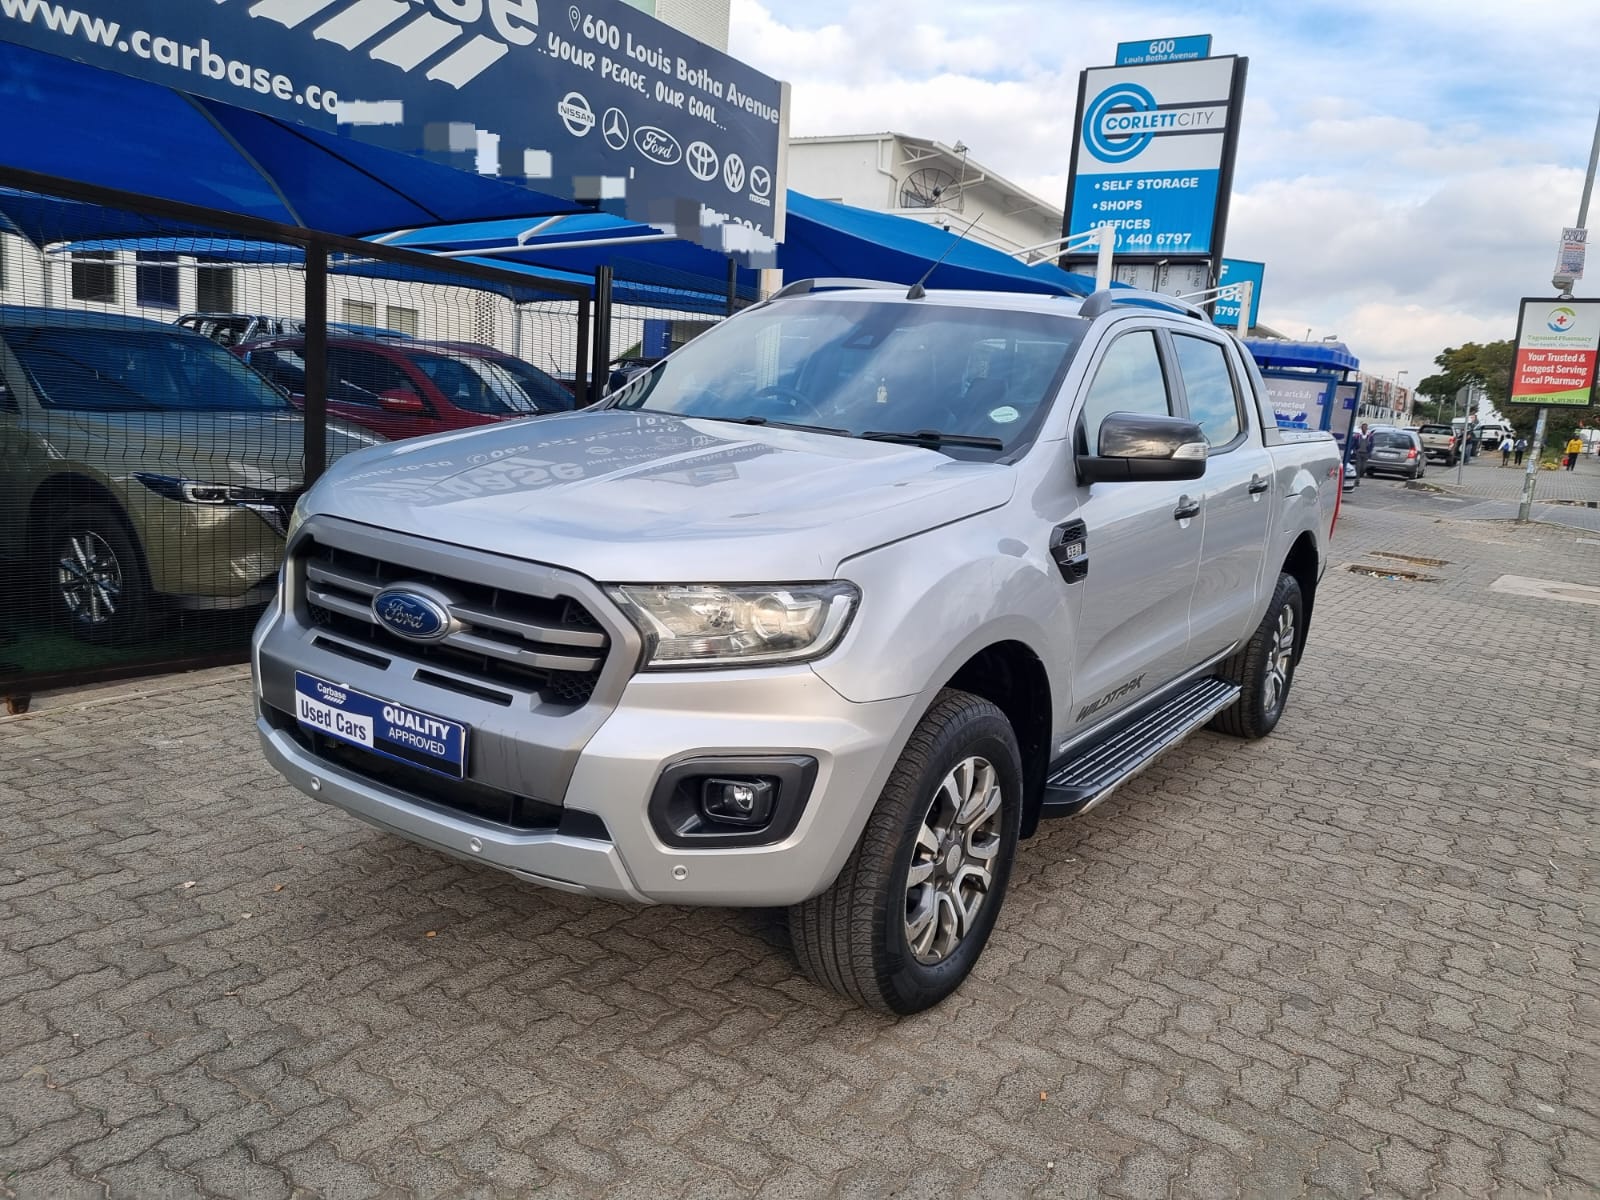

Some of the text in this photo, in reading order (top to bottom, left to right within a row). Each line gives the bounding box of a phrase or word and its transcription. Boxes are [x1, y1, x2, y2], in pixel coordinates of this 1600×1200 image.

[1149, 40, 1175, 54] 600
[1124, 51, 1199, 64] Louis Botha Avenue
[583, 14, 620, 50] 600
[626, 33, 671, 74] Louis
[676, 57, 723, 98] Botha
[727, 82, 779, 124] Avenue
[560, 104, 594, 125] NISSAN
[642, 131, 672, 160] Ford
[1102, 177, 1199, 191] SELF STORAGE
[1099, 200, 1143, 211] SHOPS
[1097, 219, 1151, 230] OFFICES
[1126, 234, 1153, 245] 440
[1156, 233, 1192, 245] 6797
[1528, 352, 1586, 362] Your Trusted &
[1522, 363, 1588, 376] Longest Serving
[1521, 375, 1585, 387] Local Pharmacy
[384, 598, 426, 630] Ford
[317, 683, 347, 700] Carbase
[1076, 672, 1148, 723] WILDTRAK
[300, 699, 367, 741] Used Cars
[382, 705, 450, 740] QUALITY
[388, 727, 446, 756] APPROVED
